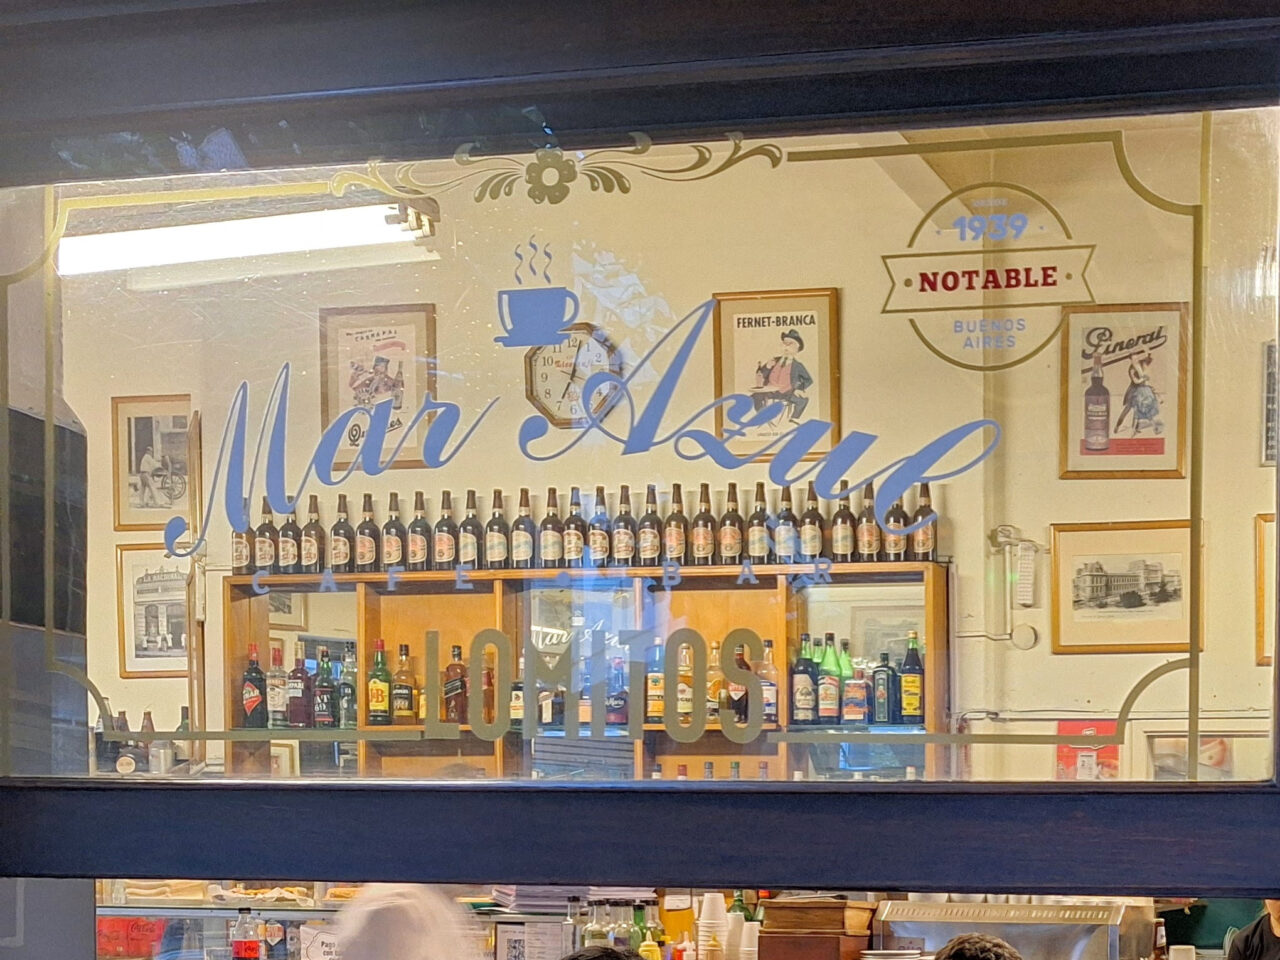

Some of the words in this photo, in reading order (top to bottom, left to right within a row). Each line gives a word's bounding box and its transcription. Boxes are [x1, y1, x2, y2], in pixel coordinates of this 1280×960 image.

[953, 213, 1029, 241] 1939
[919, 266, 1058, 293] NOTABLE
[736, 314, 816, 329] FERNET-BRANCA
[953, 318, 1026, 333] BUENOS
[963, 335, 1016, 349] AIRES
[542, 356, 554, 366] 10
[164, 361, 500, 558] Mar
[518, 297, 1002, 535] Azul
[252, 563, 474, 596] CAFE
[662, 556, 832, 587] BAR
[424, 628, 764, 744] LOMITOS
